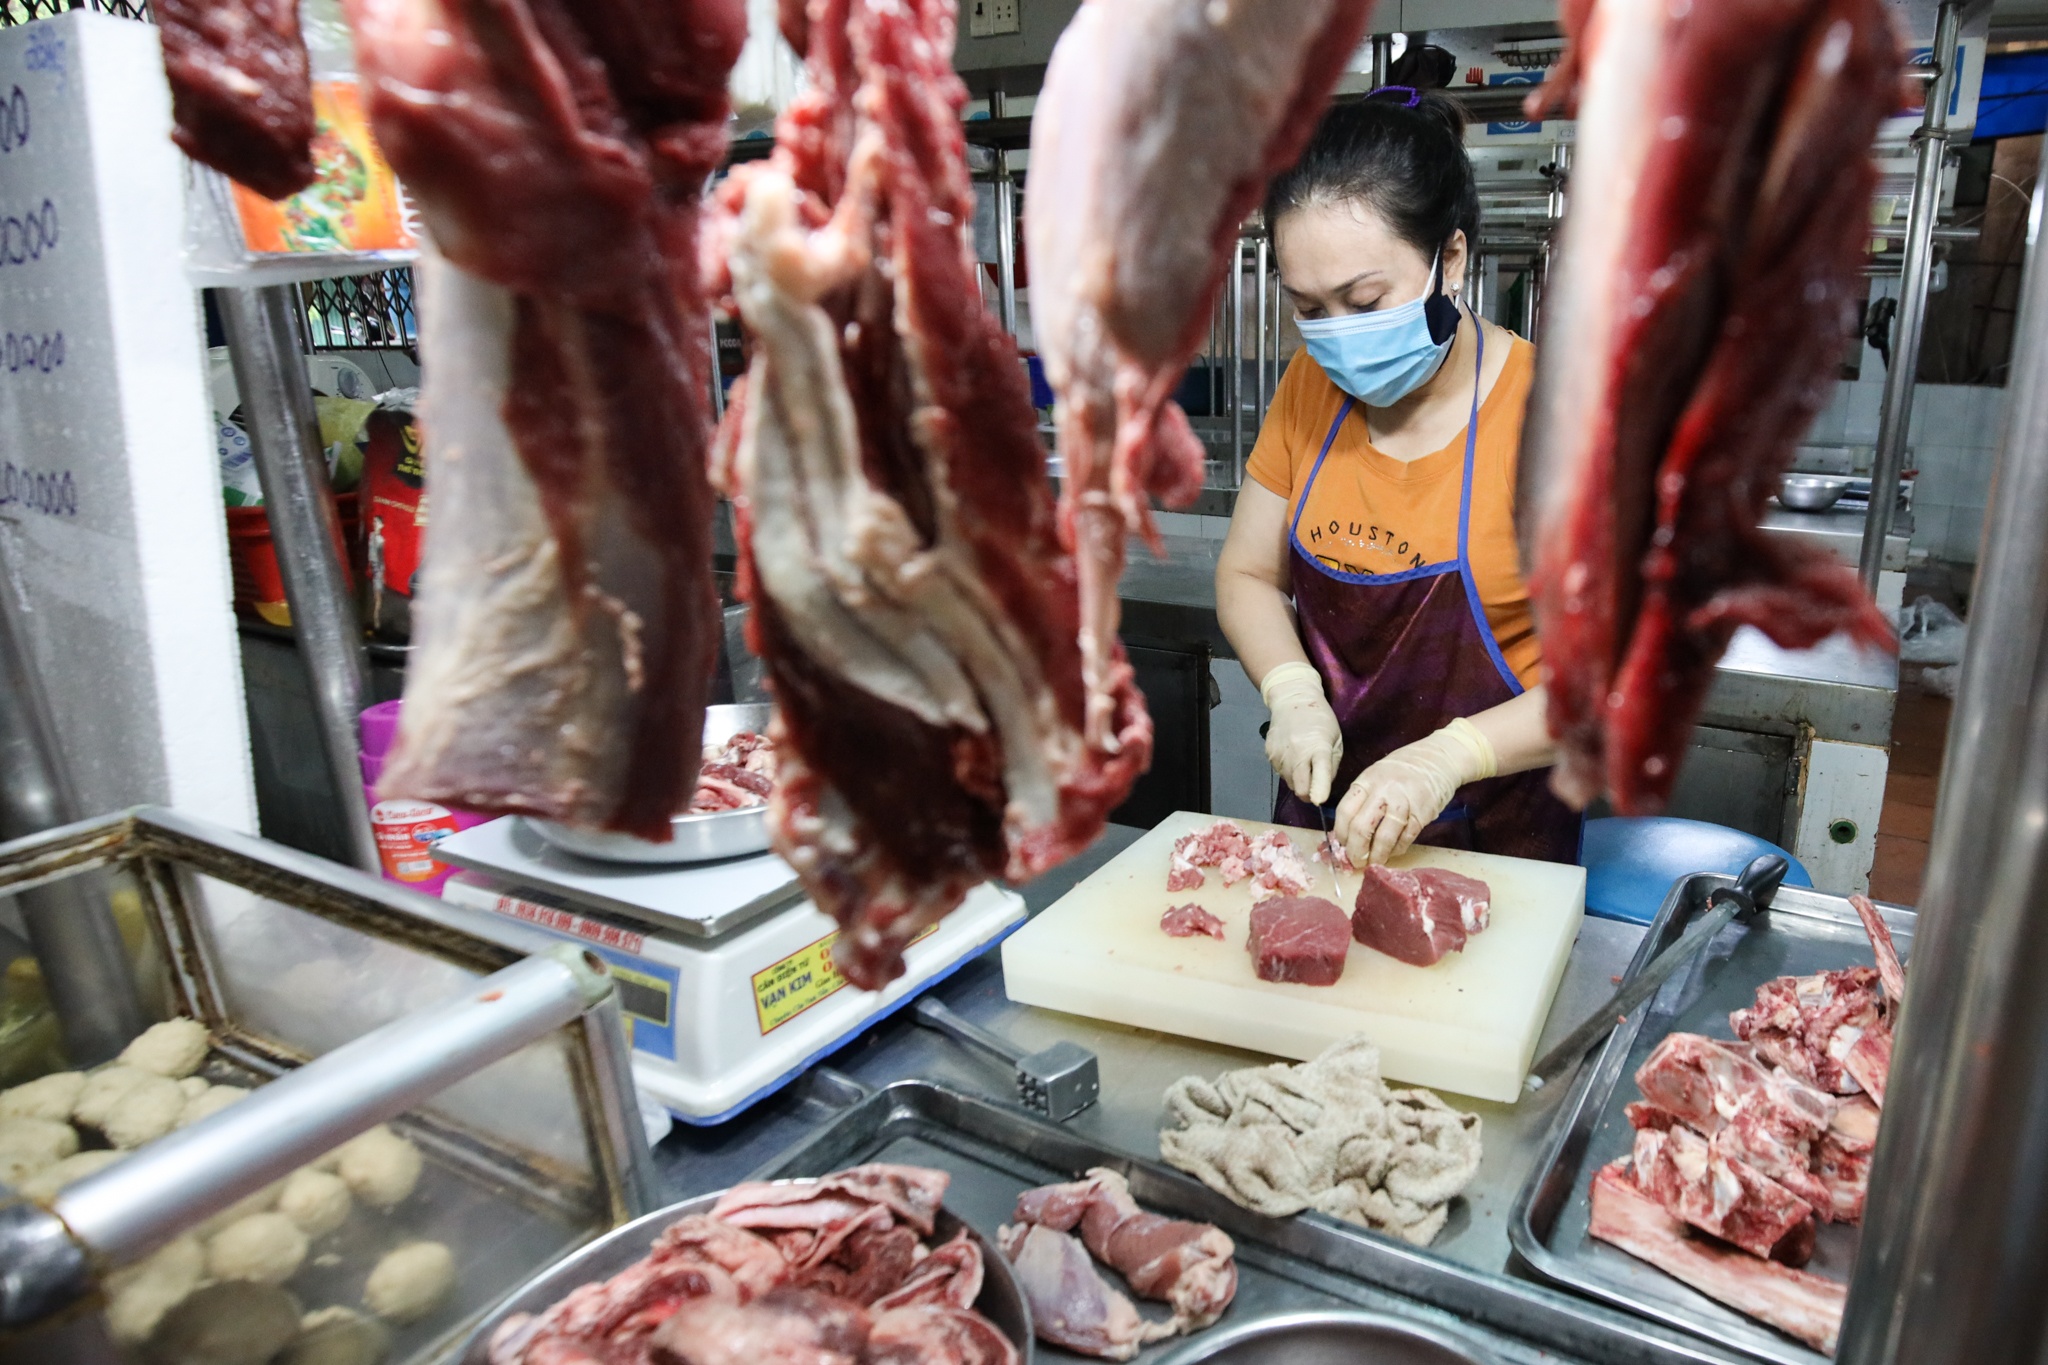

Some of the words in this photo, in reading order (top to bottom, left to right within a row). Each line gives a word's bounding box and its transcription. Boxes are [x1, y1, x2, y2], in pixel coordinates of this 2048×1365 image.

[1310, 520, 1426, 569] HOUSTON
[761, 987, 786, 1009] VẠN
[789, 972, 812, 994] KIM
